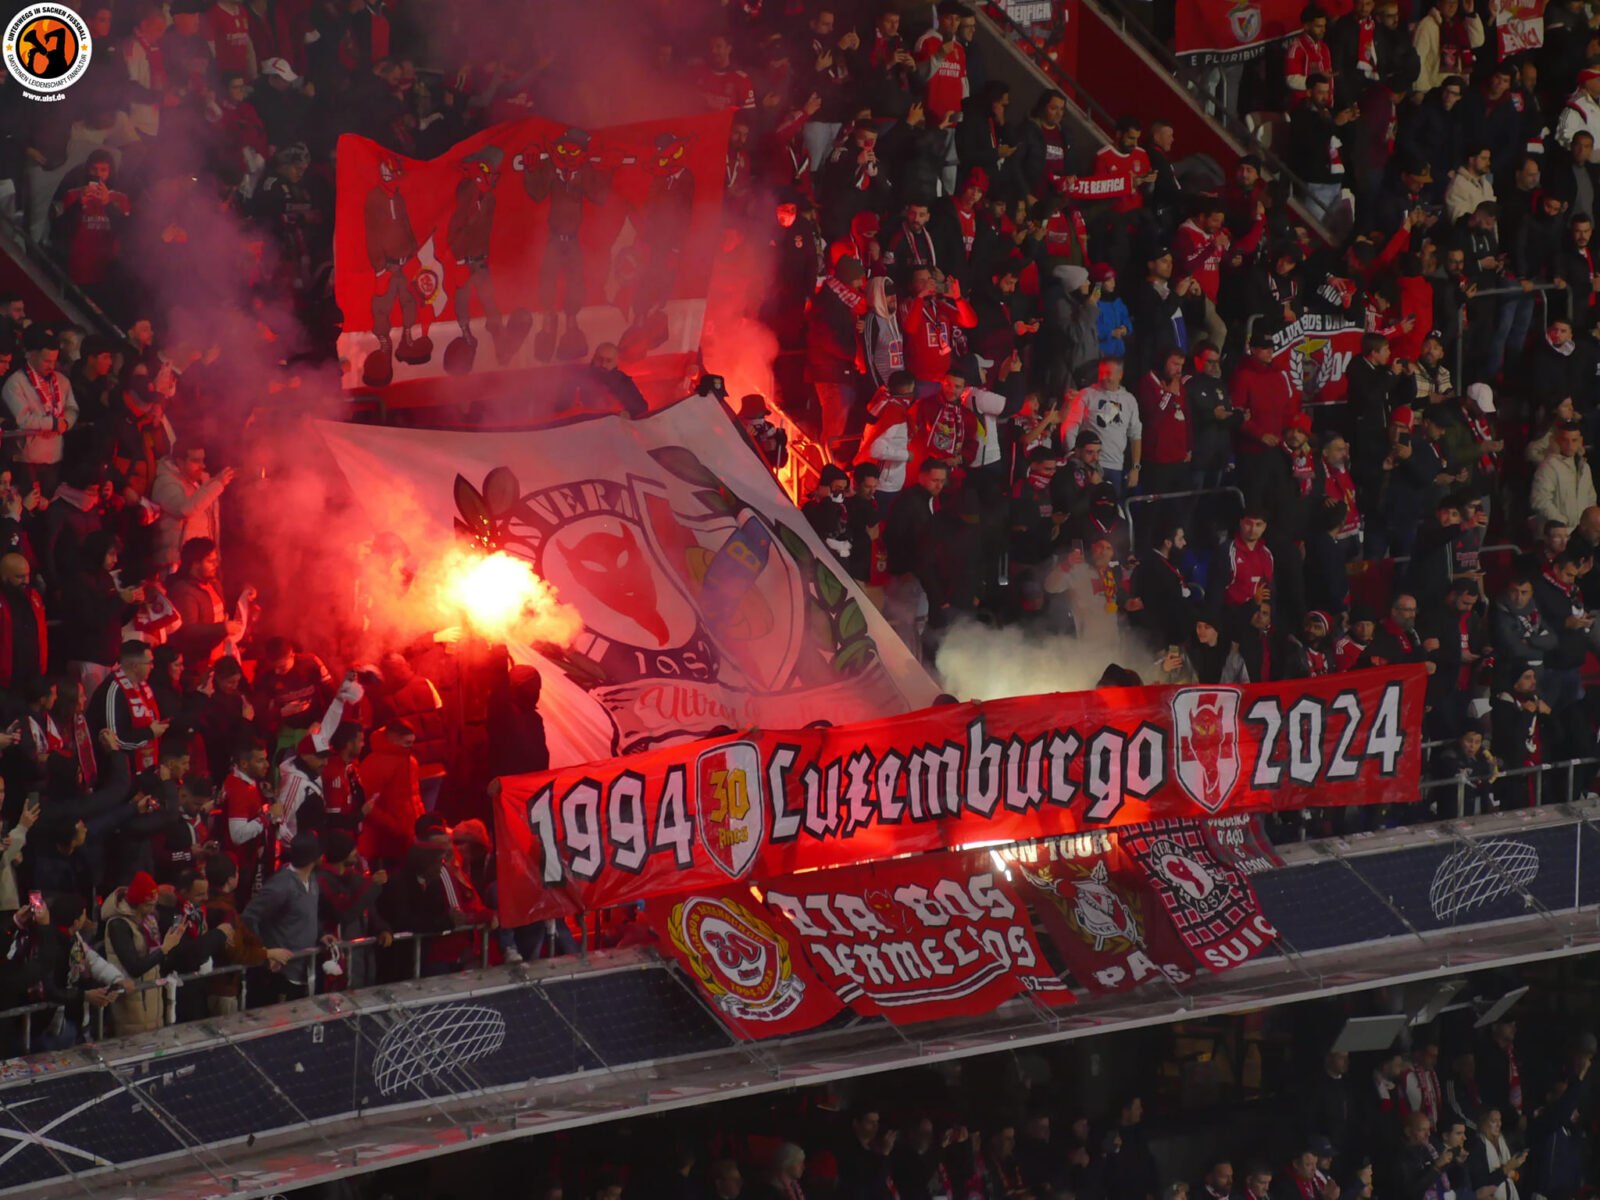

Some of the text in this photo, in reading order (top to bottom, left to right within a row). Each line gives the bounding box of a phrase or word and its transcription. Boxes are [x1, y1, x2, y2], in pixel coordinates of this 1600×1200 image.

[1190, 55, 1197, 66] E
[1090, 177, 1125, 194] BENFICA
[528, 678, 1408, 889] 1994 Luxemburgo 2024
[709, 768, 750, 824] 30
[1044, 829, 1112, 862] TOUR
[703, 930, 762, 969] 30
[1204, 915, 1277, 968] SUIÇ
[1092, 950, 1192, 988] PAS
